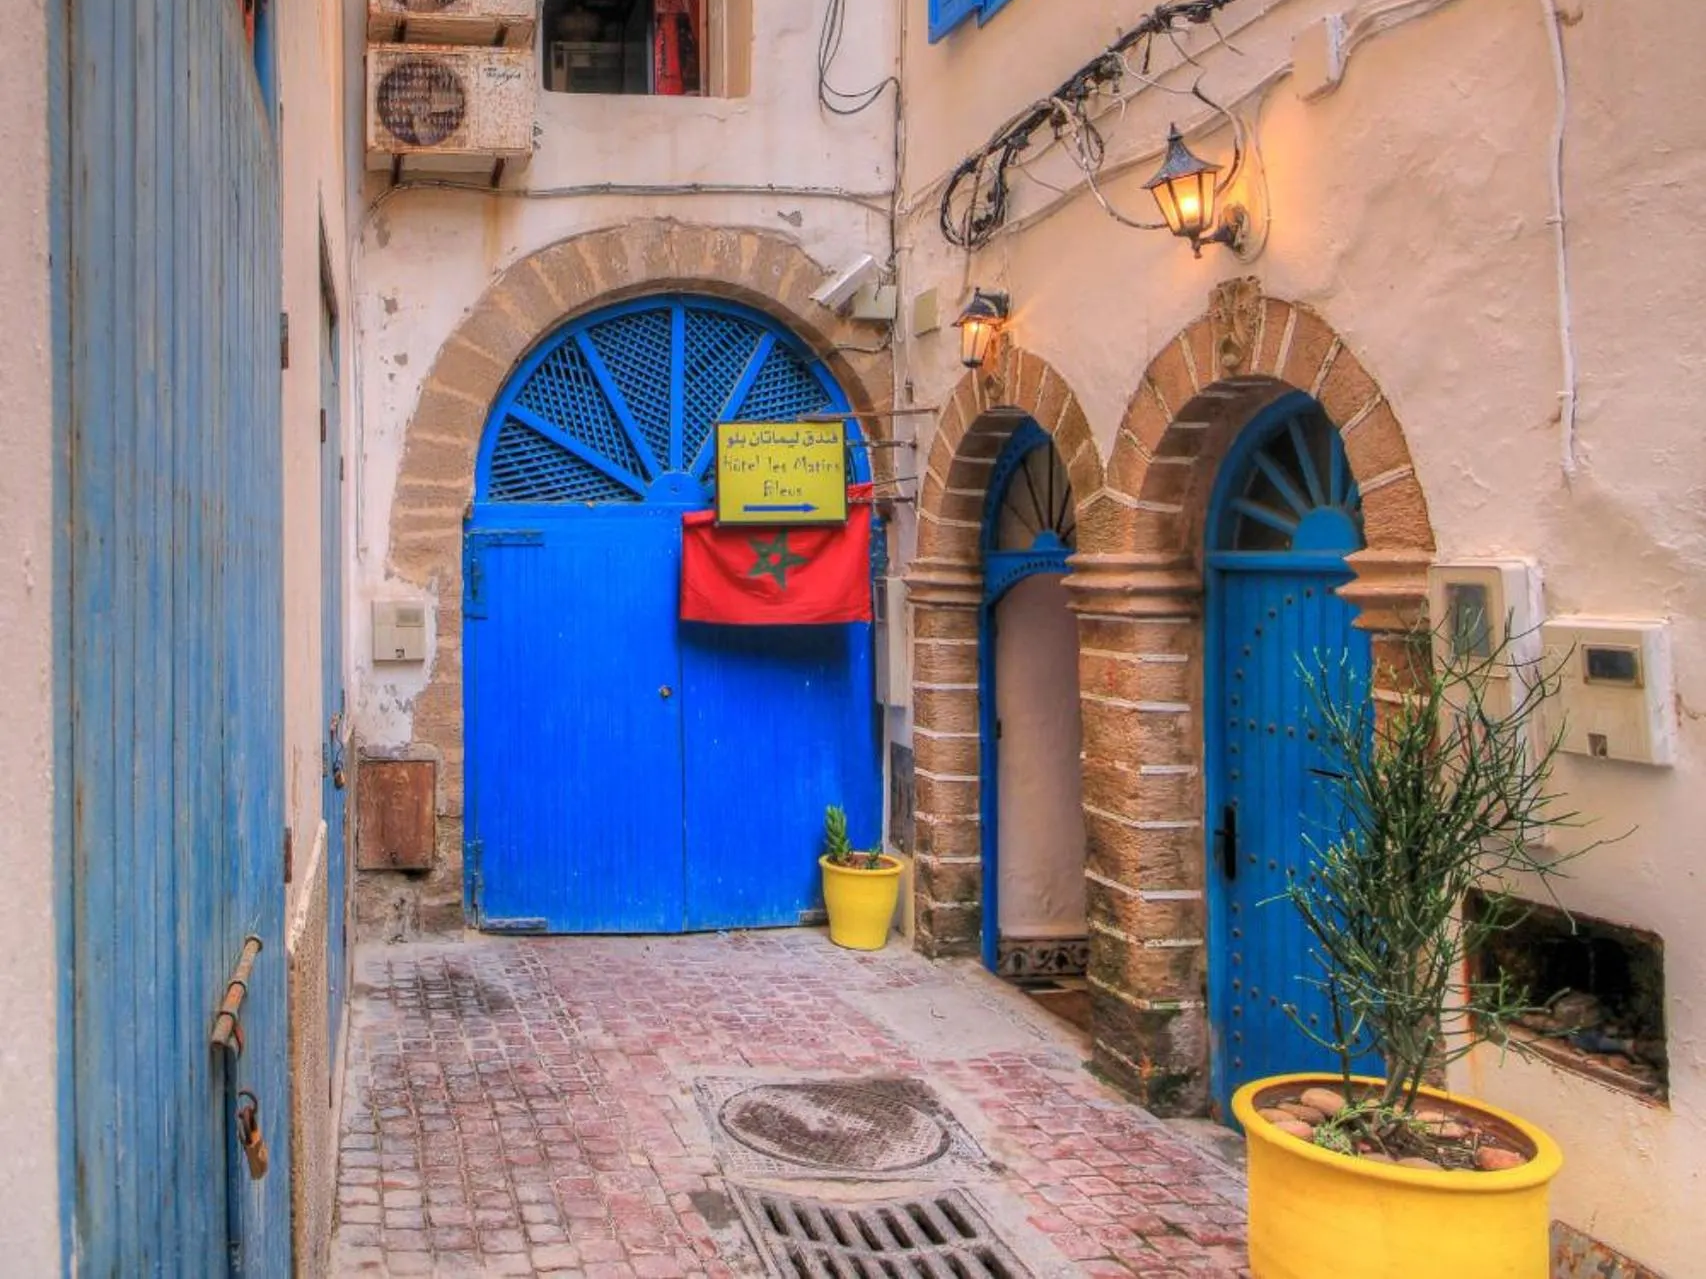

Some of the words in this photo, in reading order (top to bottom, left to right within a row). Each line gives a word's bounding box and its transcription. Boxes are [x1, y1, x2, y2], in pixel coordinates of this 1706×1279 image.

[727, 432, 746, 448] بلو
[803, 431, 838, 447] فندق
[769, 456, 786, 472] les
